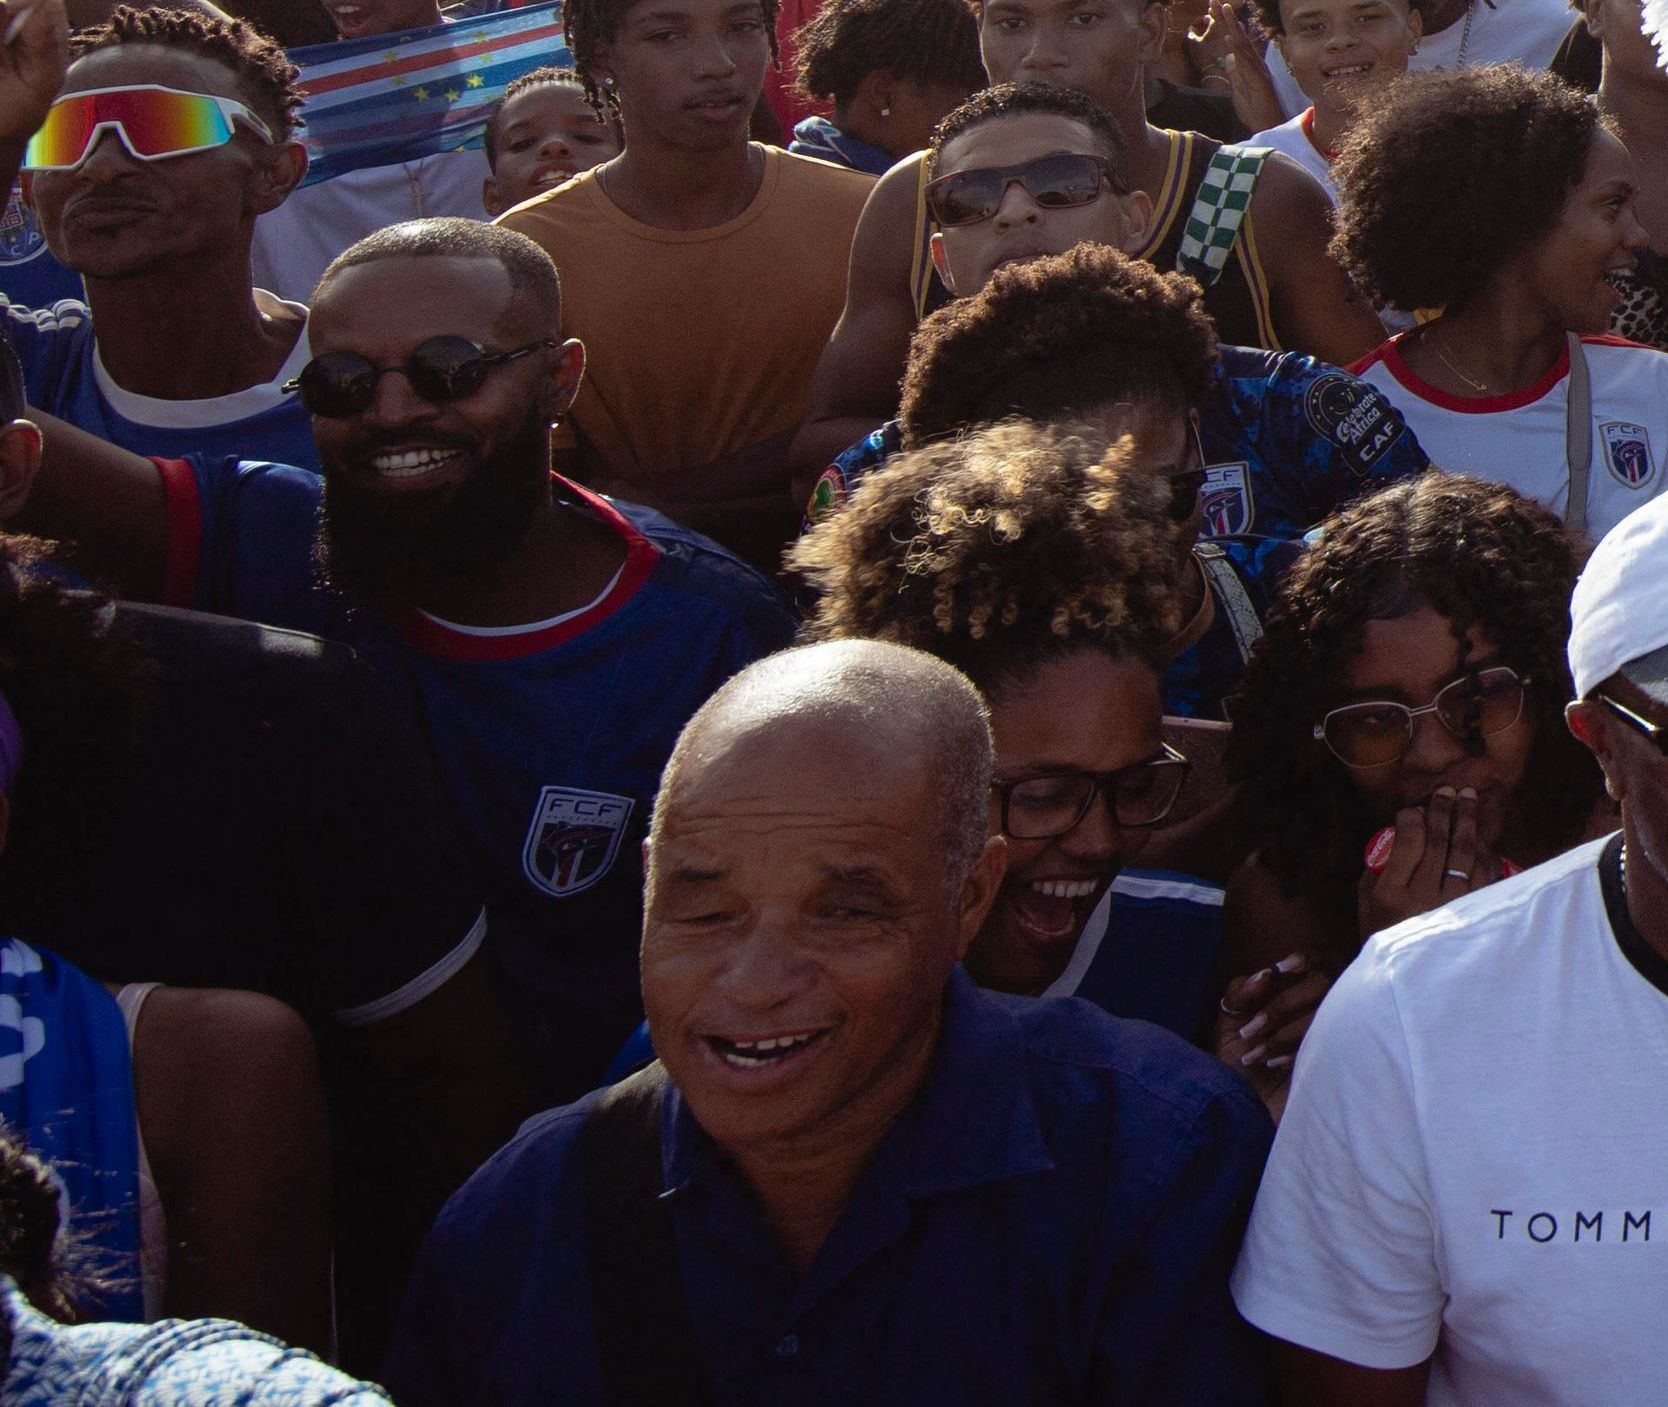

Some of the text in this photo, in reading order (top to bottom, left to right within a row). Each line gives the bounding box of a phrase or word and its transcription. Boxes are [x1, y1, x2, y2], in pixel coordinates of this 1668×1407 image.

[1335, 392, 1377, 444] Celebrate
[1349, 407, 1382, 445] Africa
[1607, 425, 1642, 436] FCF
[1359, 421, 1395, 462] CAF
[1205, 469, 1240, 483] CF
[549, 798, 622, 818] FCF
